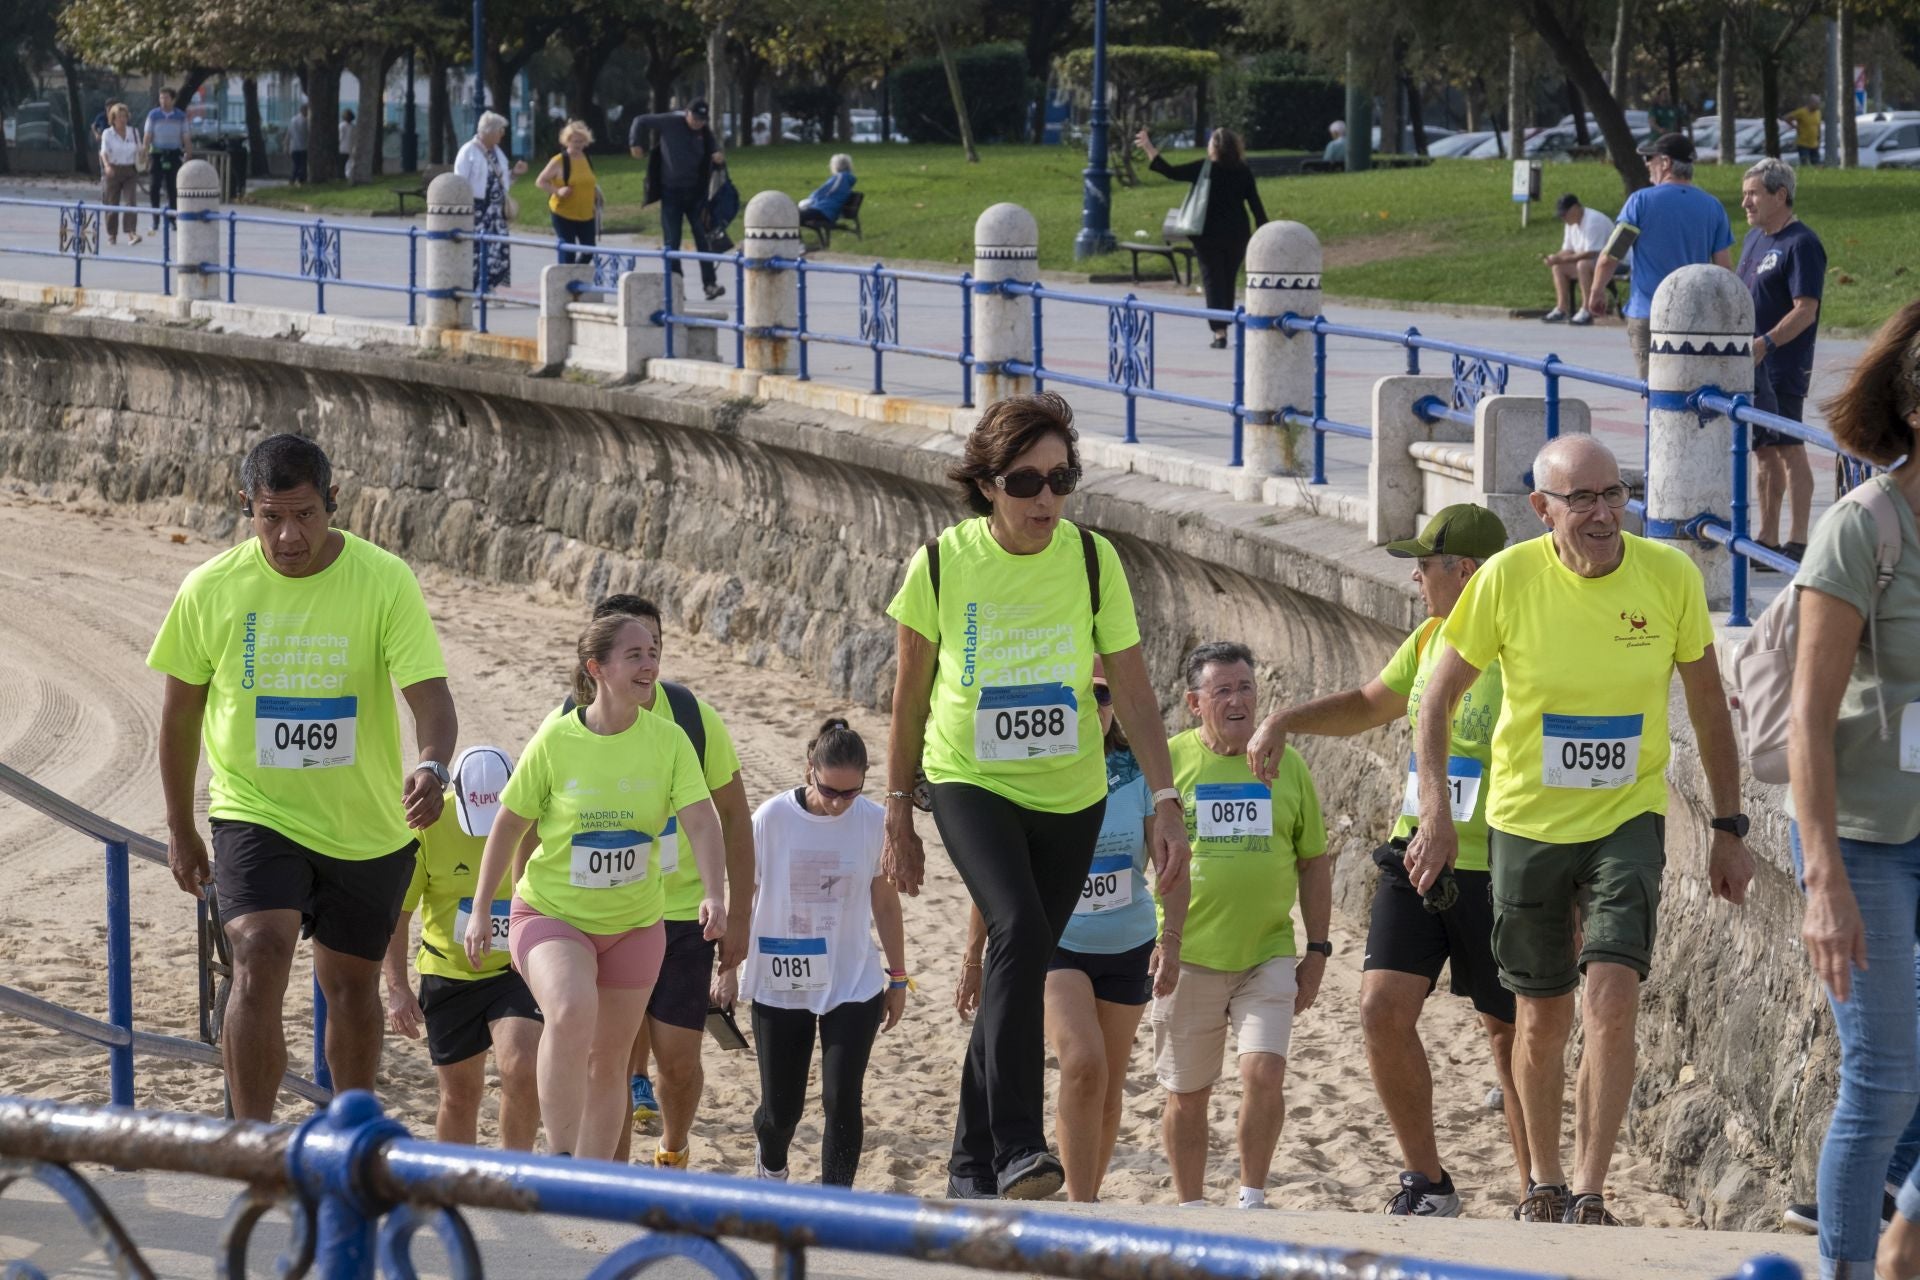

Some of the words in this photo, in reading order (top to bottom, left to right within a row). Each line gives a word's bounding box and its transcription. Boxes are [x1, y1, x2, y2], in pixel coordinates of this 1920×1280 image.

[259, 633, 280, 648] En
[284, 632, 350, 649] marcha
[981, 624, 1005, 641] En
[1008, 623, 1074, 641] marcha
[241, 612, 257, 690] Cantabria
[961, 602, 978, 688] Cantabria
[981, 642, 1050, 660] contra
[259, 649, 324, 666] contra
[327, 648, 349, 666] el
[259, 667, 349, 690] cáncer
[978, 661, 1078, 687] cáncer
[995, 707, 1065, 740] 0588
[274, 722, 338, 751] 0469
[1561, 741, 1626, 771] 0598
[580, 810, 618, 820] MADRID
[621, 810, 634, 819] EN
[1211, 801, 1258, 823] 0876
[581, 820, 622, 829] MARCHA
[589, 848, 635, 874] 0110
[1082, 874, 1117, 899] 960
[491, 917, 510, 938] 63
[772, 956, 811, 978] 0181
